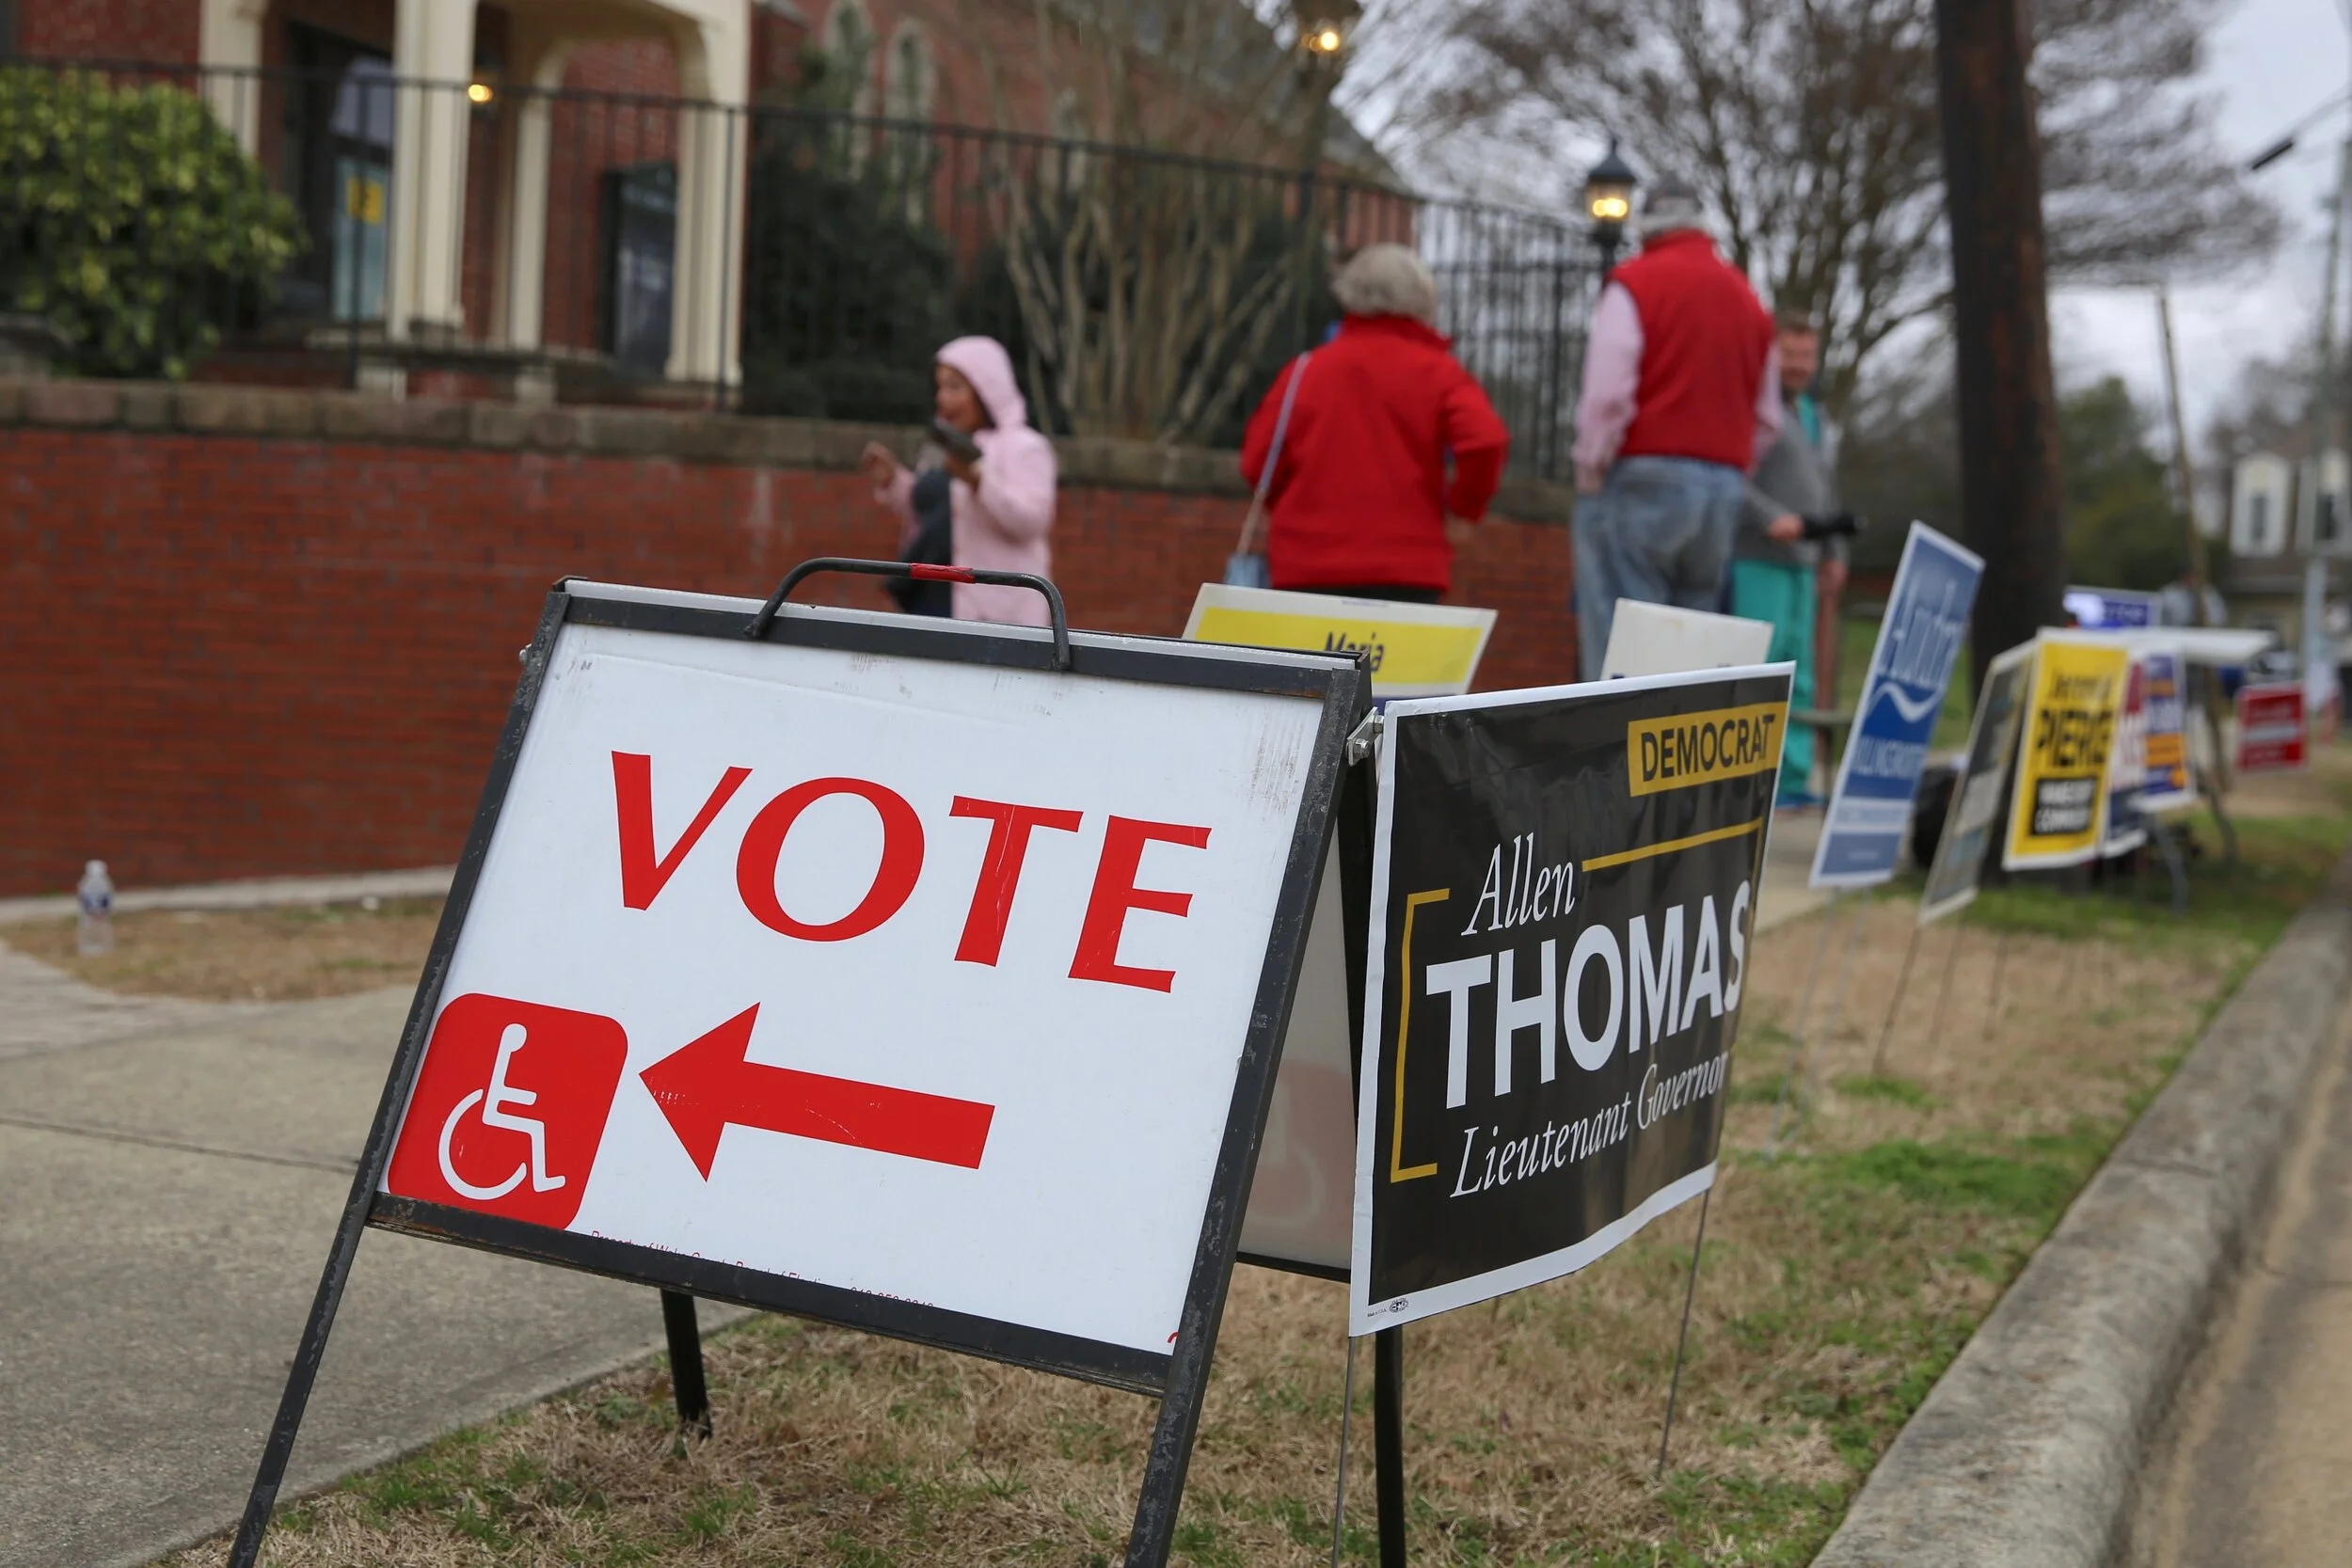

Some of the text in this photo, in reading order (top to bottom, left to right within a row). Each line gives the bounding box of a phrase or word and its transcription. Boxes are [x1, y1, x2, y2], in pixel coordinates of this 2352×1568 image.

[1326, 631, 1385, 672] Mia
[1641, 714, 1775, 782] DEMOCRAT
[612, 751, 1212, 993] VOTE
[1460, 832, 1576, 937] Allen
[1426, 879, 1751, 1110] THOMAS
[1450, 1050, 1728, 1198] Lieutenant Governor
